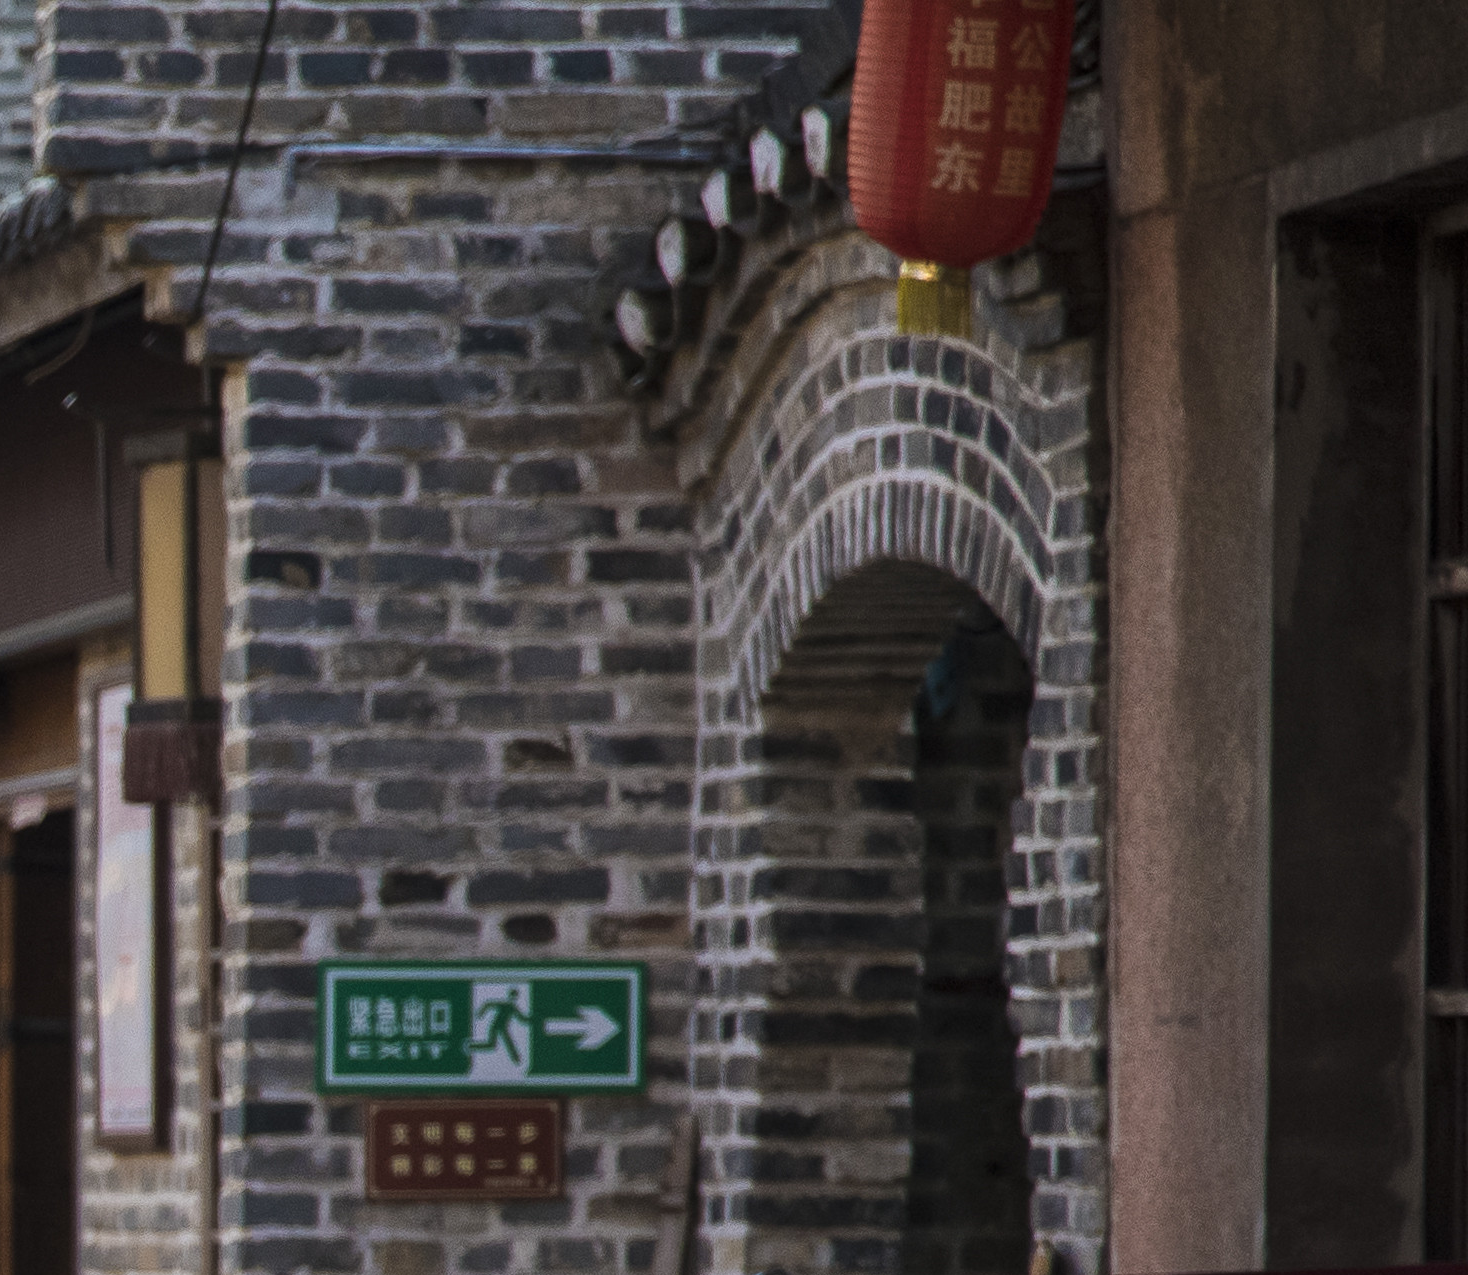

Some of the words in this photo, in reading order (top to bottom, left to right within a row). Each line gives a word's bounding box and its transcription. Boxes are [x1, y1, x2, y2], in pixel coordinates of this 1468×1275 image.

[931, 0, 999, 193] 福肥东
[993, 0, 1056, 197] 公故里
[348, 1040, 448, 1060] EXIT
